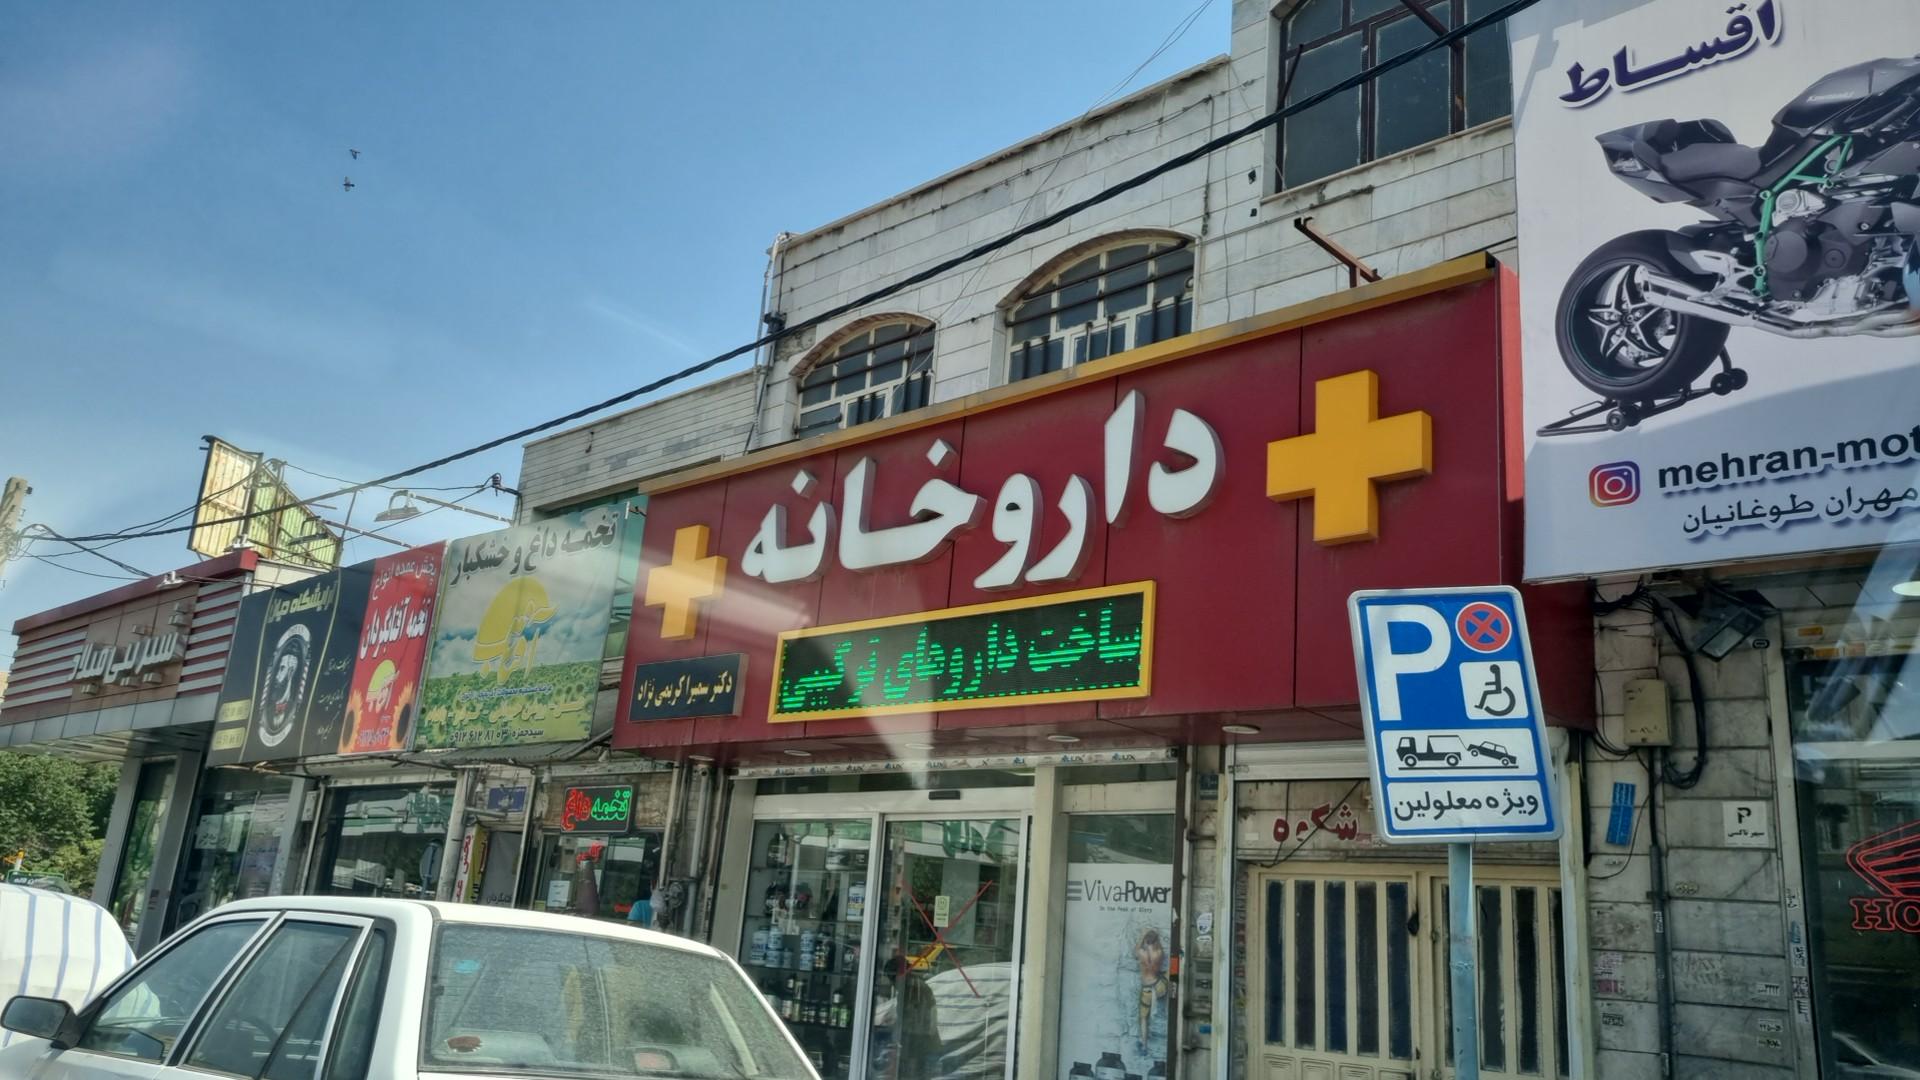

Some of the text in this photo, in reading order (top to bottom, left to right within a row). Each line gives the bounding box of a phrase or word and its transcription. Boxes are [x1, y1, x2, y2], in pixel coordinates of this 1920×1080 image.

[1558, 0, 1776, 103] اقساط
[741, 388, 1225, 590] داروخانه
[1683, 486, 1919, 534] مهران طوغانیان
[449, 513, 619, 586] تخمه داغ و خشکبار
[637, 670, 733, 709] دکتر سمیرا کریمی نژاد
[780, 600, 1141, 709] ساخت داروهای ترکیبی
[1366, 604, 1452, 721] P
[560, 787, 630, 832] تخمه داغ
[1394, 787, 1539, 822] ویژه معلولین
